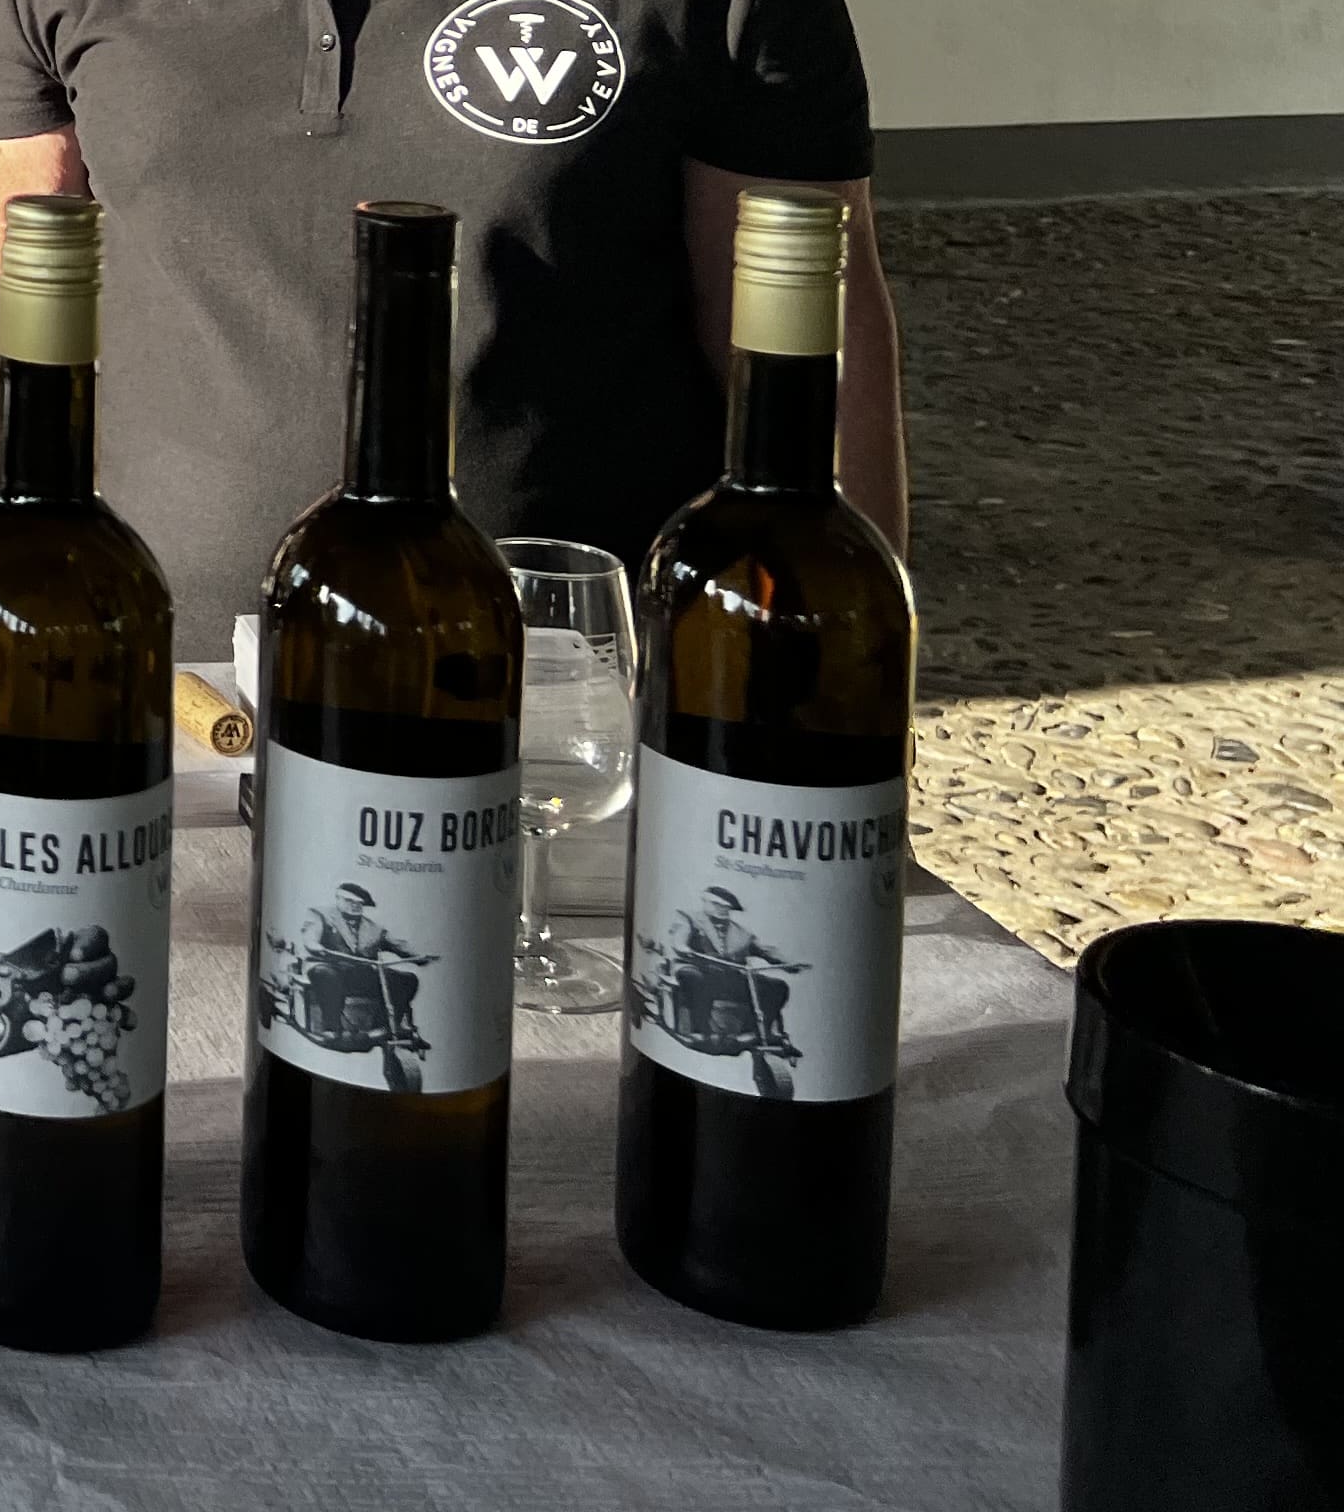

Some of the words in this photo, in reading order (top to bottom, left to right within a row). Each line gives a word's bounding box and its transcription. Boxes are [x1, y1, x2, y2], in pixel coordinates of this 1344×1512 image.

[432, 17, 476, 103] VIGNES
[512, 118, 539, 135] DE
[578, 22, 618, 116] VEVEY
[76, 809, 171, 874] ALLOU
[359, 806, 425, 852] OUZ
[717, 808, 903, 862] CHAVONCH
